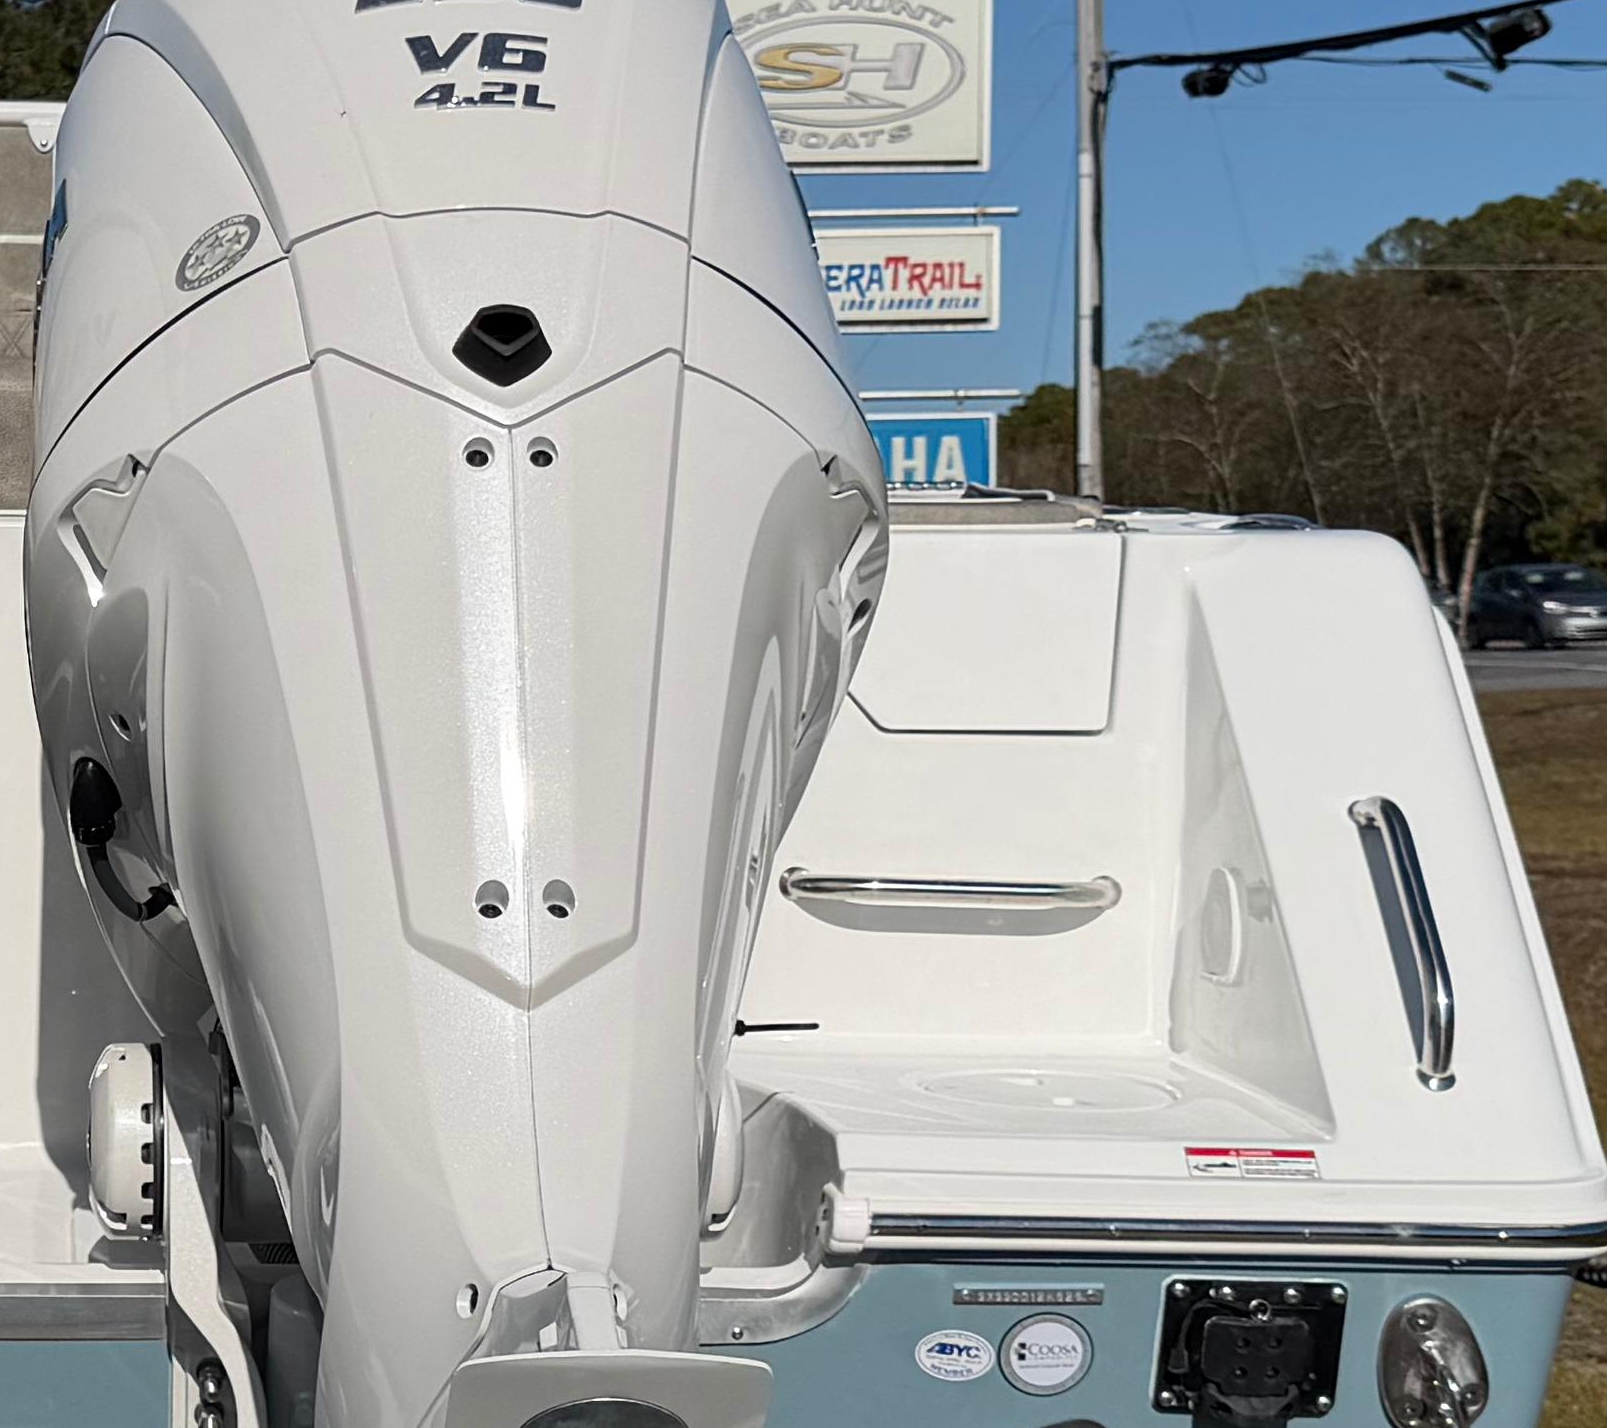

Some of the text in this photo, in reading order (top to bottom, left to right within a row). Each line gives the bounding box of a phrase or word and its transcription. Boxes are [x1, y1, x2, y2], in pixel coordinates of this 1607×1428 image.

[404, 32, 549, 75] V6
[413, 82, 557, 113] 4.2L
[777, 124, 914, 150] BOATS
[824, 256, 982, 299] ERATRAIL
[890, 435, 967, 482] HA
[926, 1342, 981, 1359] ABYC
[1027, 1343, 1078, 1356] COOSA
